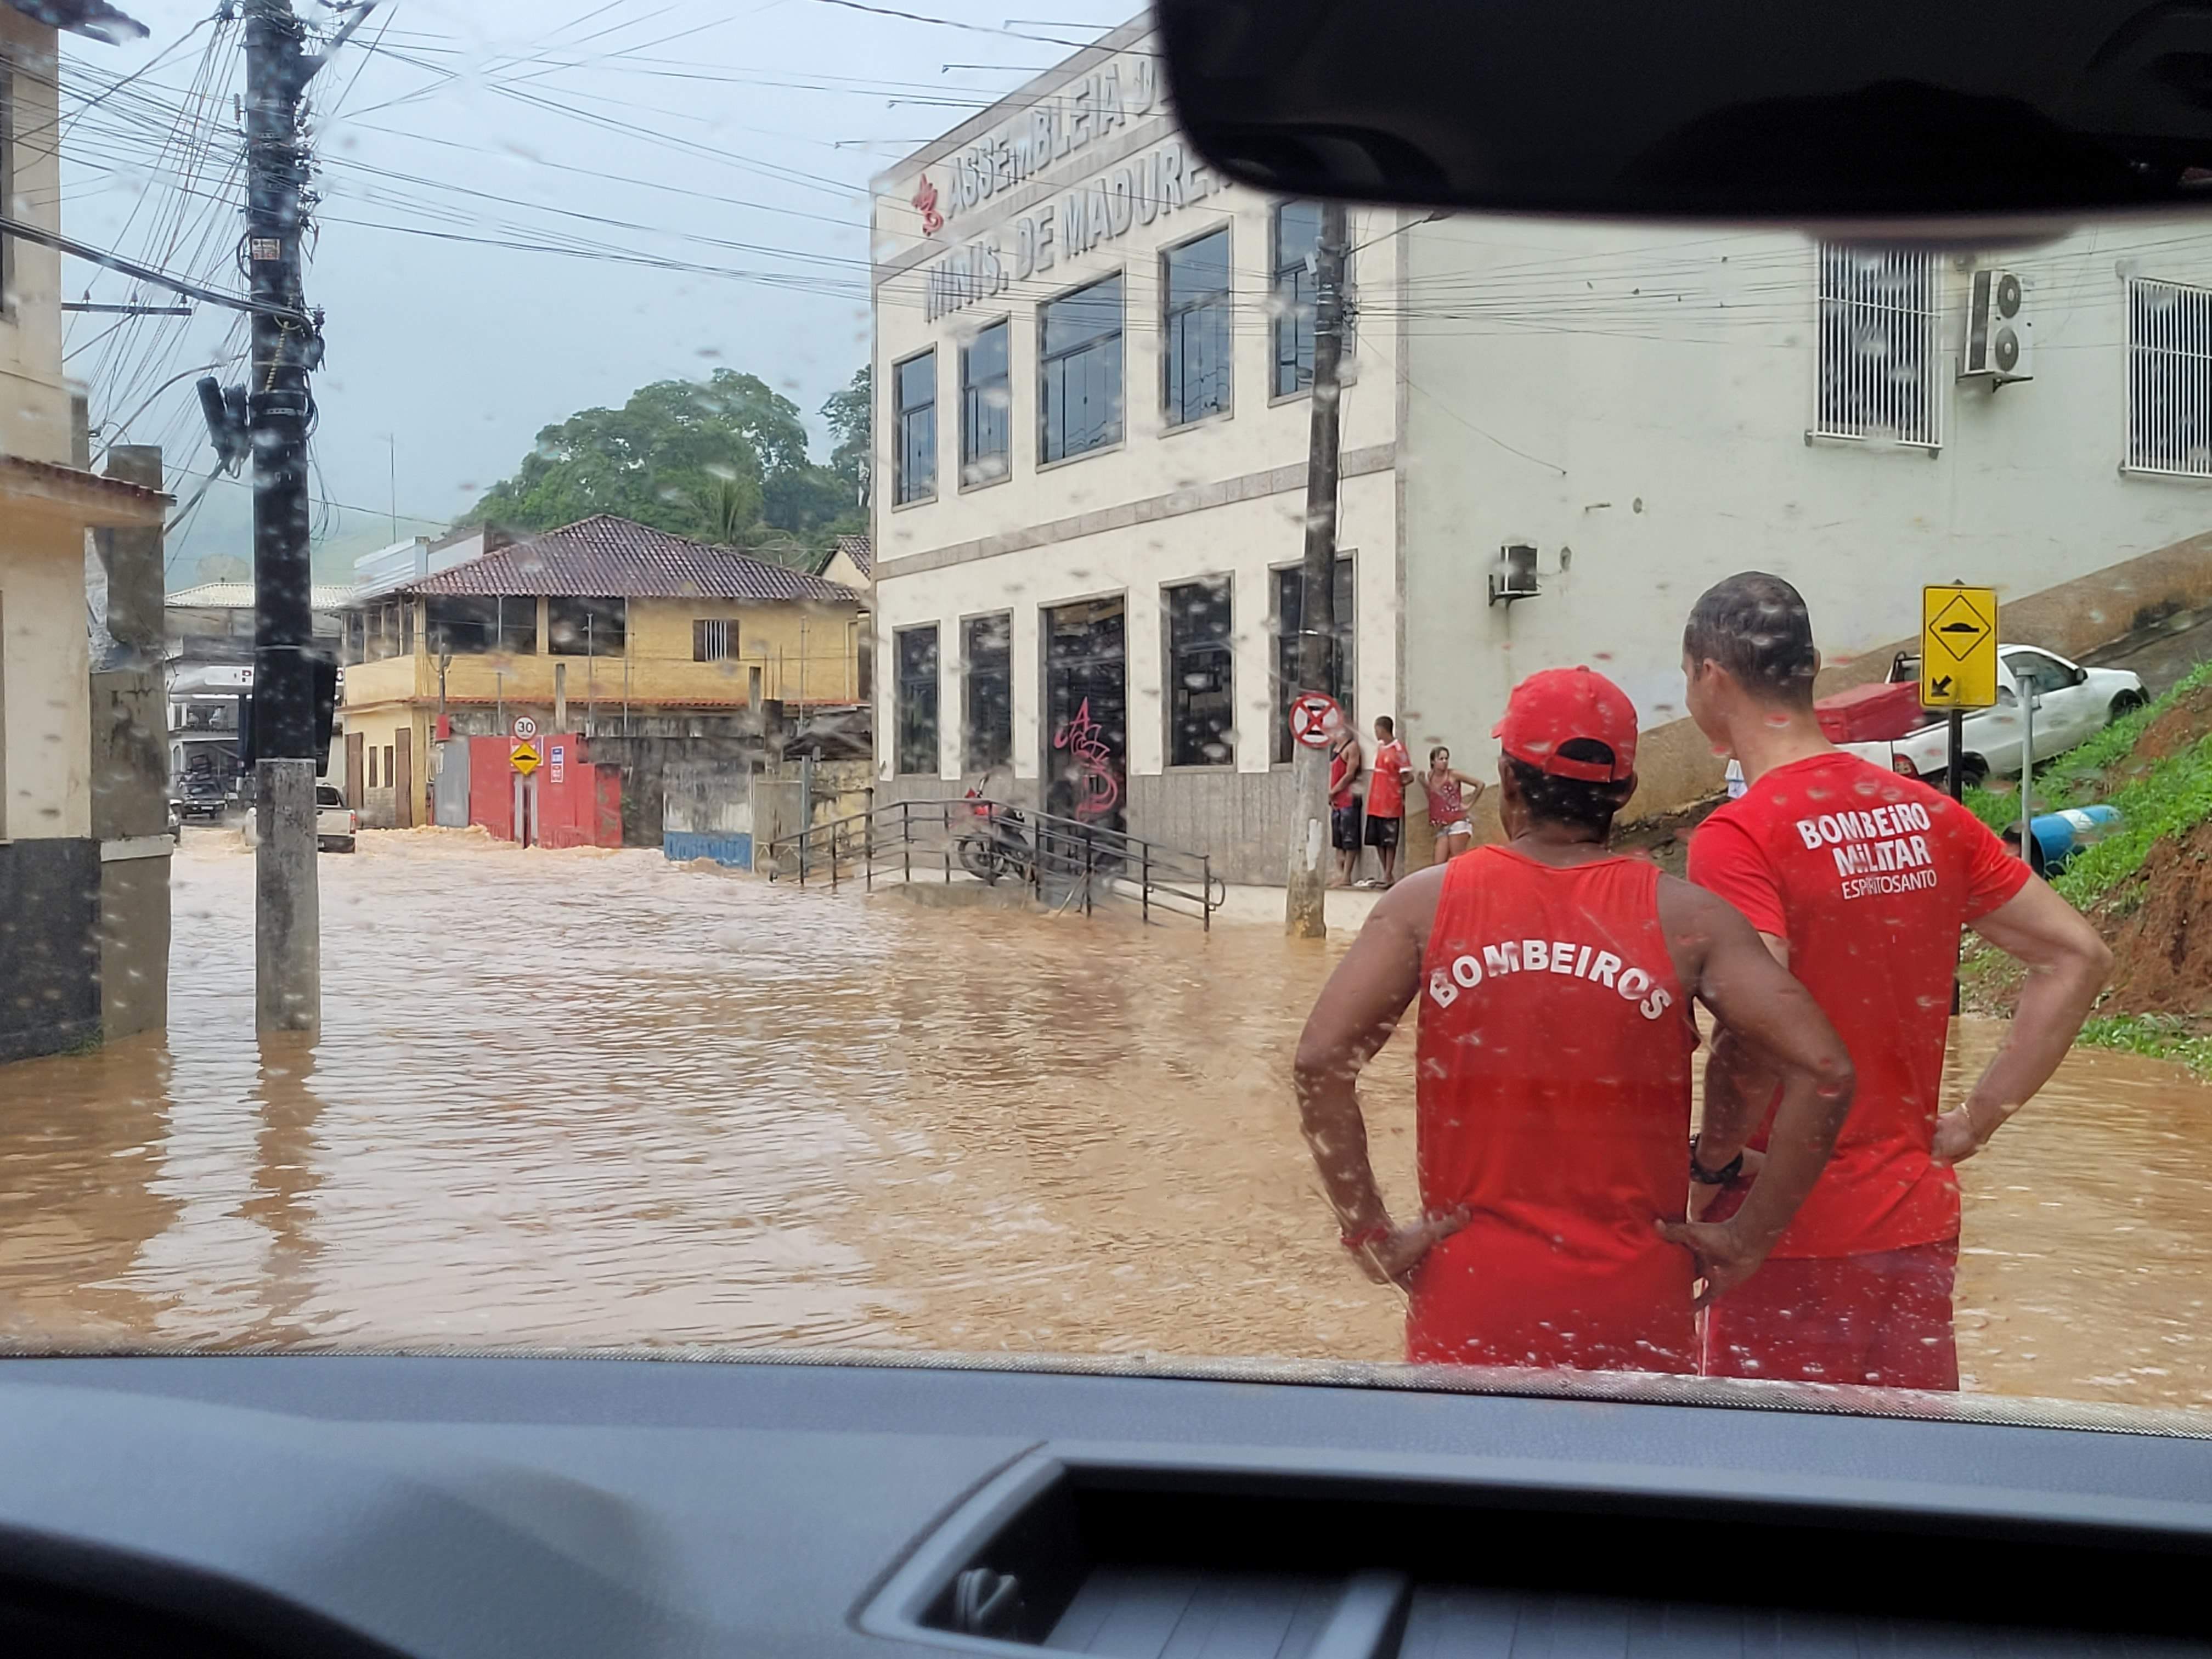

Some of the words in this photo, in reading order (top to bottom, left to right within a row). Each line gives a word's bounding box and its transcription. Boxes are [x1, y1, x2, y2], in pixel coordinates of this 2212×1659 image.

[1015, 205, 1054, 280] DE
[518, 721, 533, 733] 30
[1429, 940, 1672, 1020] BOMBEIROS
